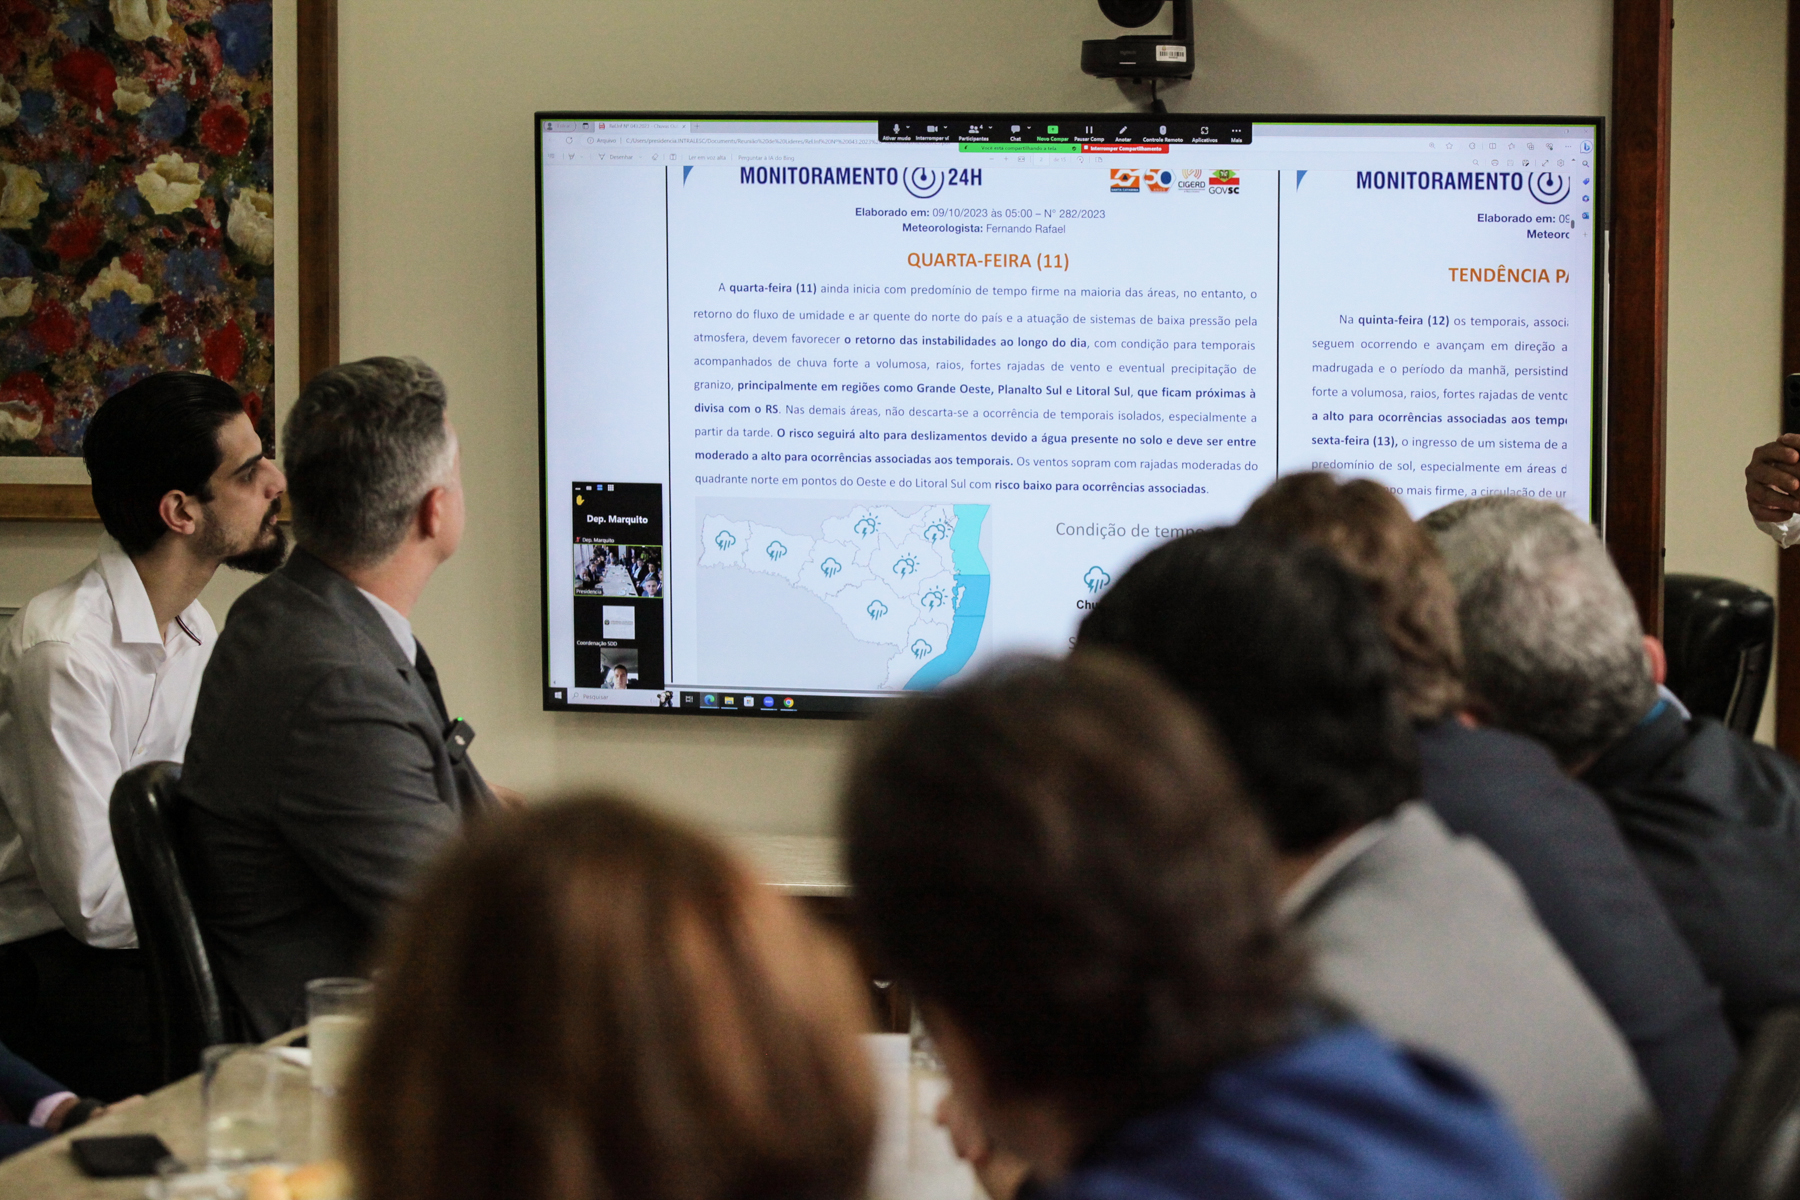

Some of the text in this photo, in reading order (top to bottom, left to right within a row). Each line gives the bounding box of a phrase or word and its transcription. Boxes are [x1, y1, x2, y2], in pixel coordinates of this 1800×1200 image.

[740, 166, 982, 186] MONITORAMENTO 24H
[1356, 171, 1524, 191] MONITORAMENTO
[854, 206, 908, 217] Elaborado
[910, 209, 930, 217] em:
[932, 207, 988, 218] 09/10/2023
[990, 208, 1002, 218] às
[1004, 208, 1032, 218] 05:00
[1058, 208, 1106, 219] 282/2023
[1477, 212, 1532, 223] Elaborado
[1535, 215, 1556, 223] em:
[902, 222, 1066, 234] Meteorologista: Fernando Rafael
[907, 252, 1069, 271] QUARTA-FEIRA (11)
[1448, 264, 1550, 283] TENDÊNCIA
[718, 282, 1257, 300] A quarta-feira (11) ainda inicia com predomínio de tempo firme na maioria das áreas, no entanto, o
[1339, 314, 1569, 328] Na quinta-feira (12) os temporais, associ
[693, 332, 1255, 352] atmosfera, devem favorecer o retorno das instabilidades ao longo do dia, com condição para temporais
[1312, 362, 1373, 375] madrugada
[1378, 365, 1385, 373] e
[1389, 365, 1397, 373] o
[1401, 363, 1445, 376] período
[1449, 363, 1463, 374] da
[1468, 364, 1509, 377] manhã,
[693, 379, 1256, 400] granizo, principalmente em regiões como Grande Oeste, Planalto Sul e Litoral Sul, que ficam próximas à
[1311, 410, 1568, 427] a alto para ocorrências associadas aos temp
[694, 449, 1258, 471] moderado a alto para ocorrências associadas aos temporais. Os ventos sopram com rajadas moderadas do
[586, 514, 648, 525] Dep. Marquito
[1056, 522, 1126, 540] Condição
[1131, 524, 1149, 538] de
